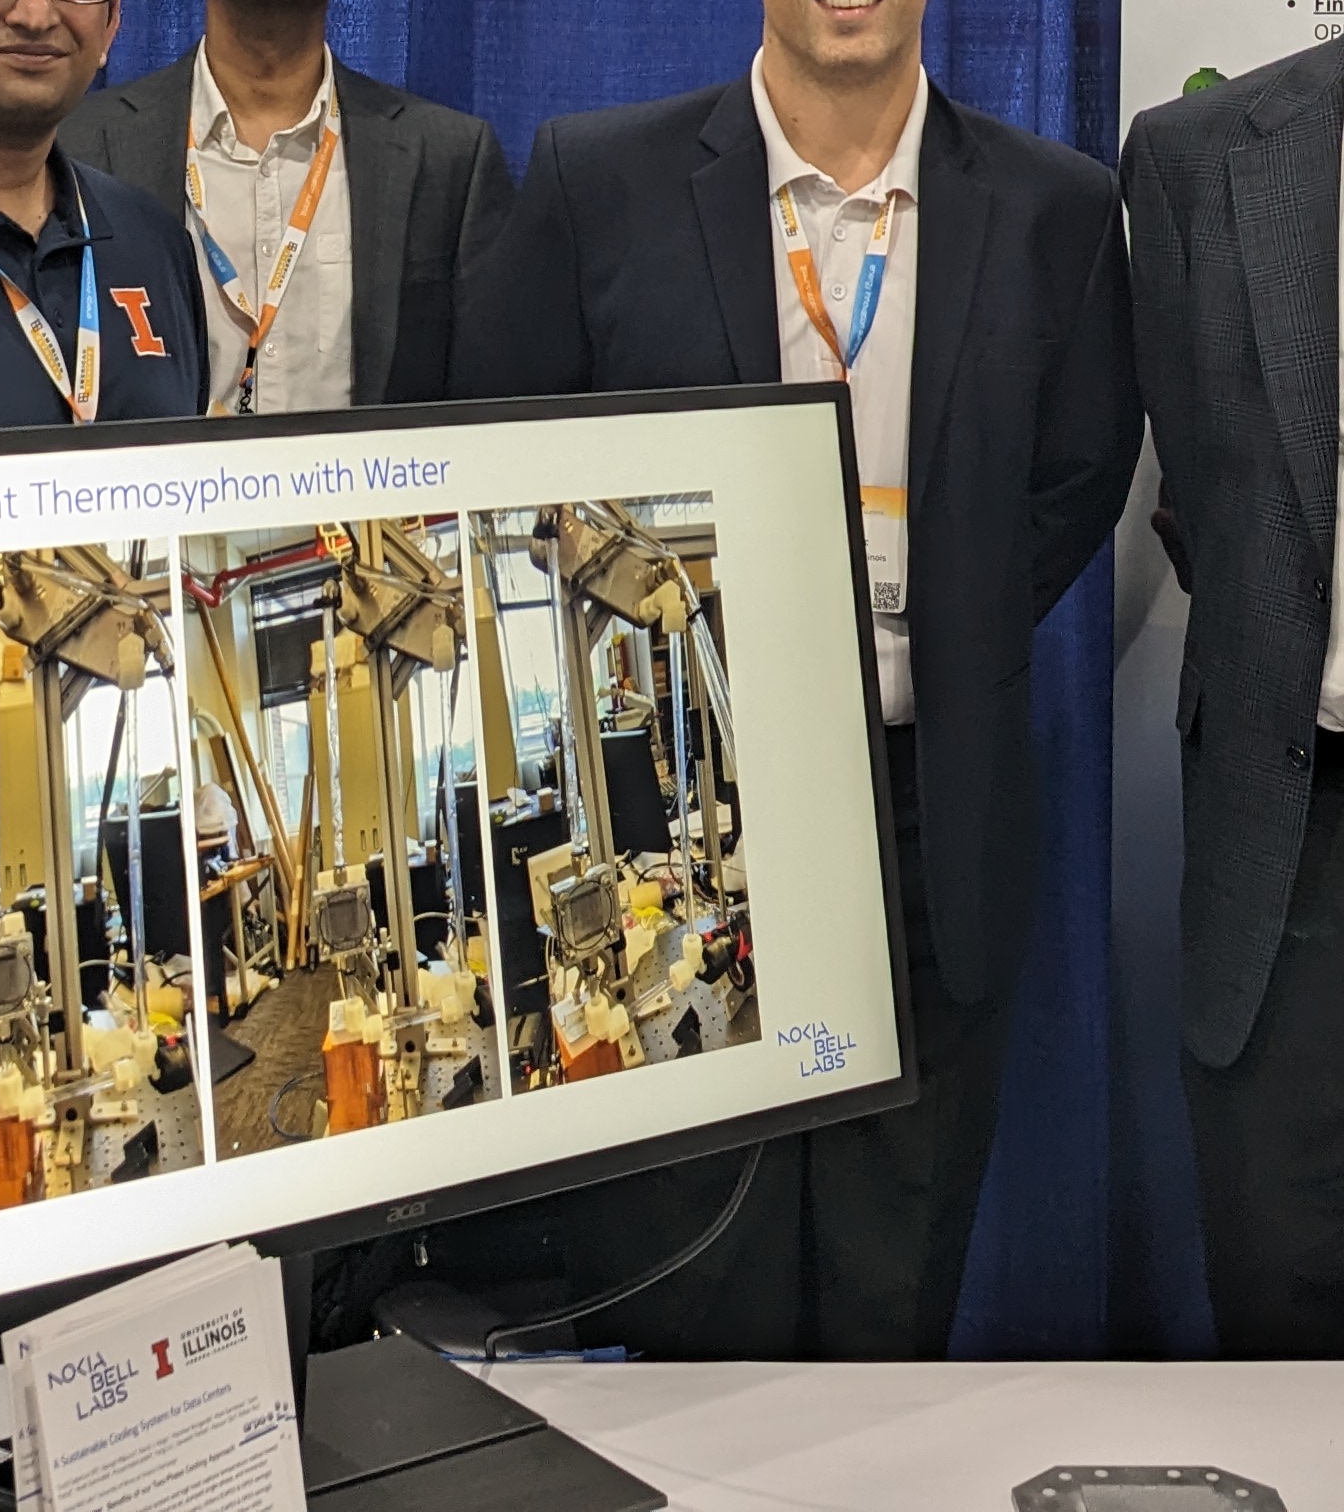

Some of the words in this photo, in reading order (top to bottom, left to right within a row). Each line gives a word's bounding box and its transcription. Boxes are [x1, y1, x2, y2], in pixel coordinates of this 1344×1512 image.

[110, 287, 167, 357] I
[30, 463, 280, 518] Thermosyphon
[288, 458, 354, 497] with
[362, 455, 452, 491] Water
[867, 553, 887, 563] inois
[777, 1021, 830, 1047] NOKIA
[814, 1032, 857, 1056] BELL
[800, 1051, 846, 1077] LABS
[386, 1198, 435, 1223] acer
[183, 1317, 247, 1358] ILLINOIS
[48, 1351, 107, 1390] NOKIA
[90, 1358, 140, 1393] BELL
[76, 1382, 129, 1421] LABS
